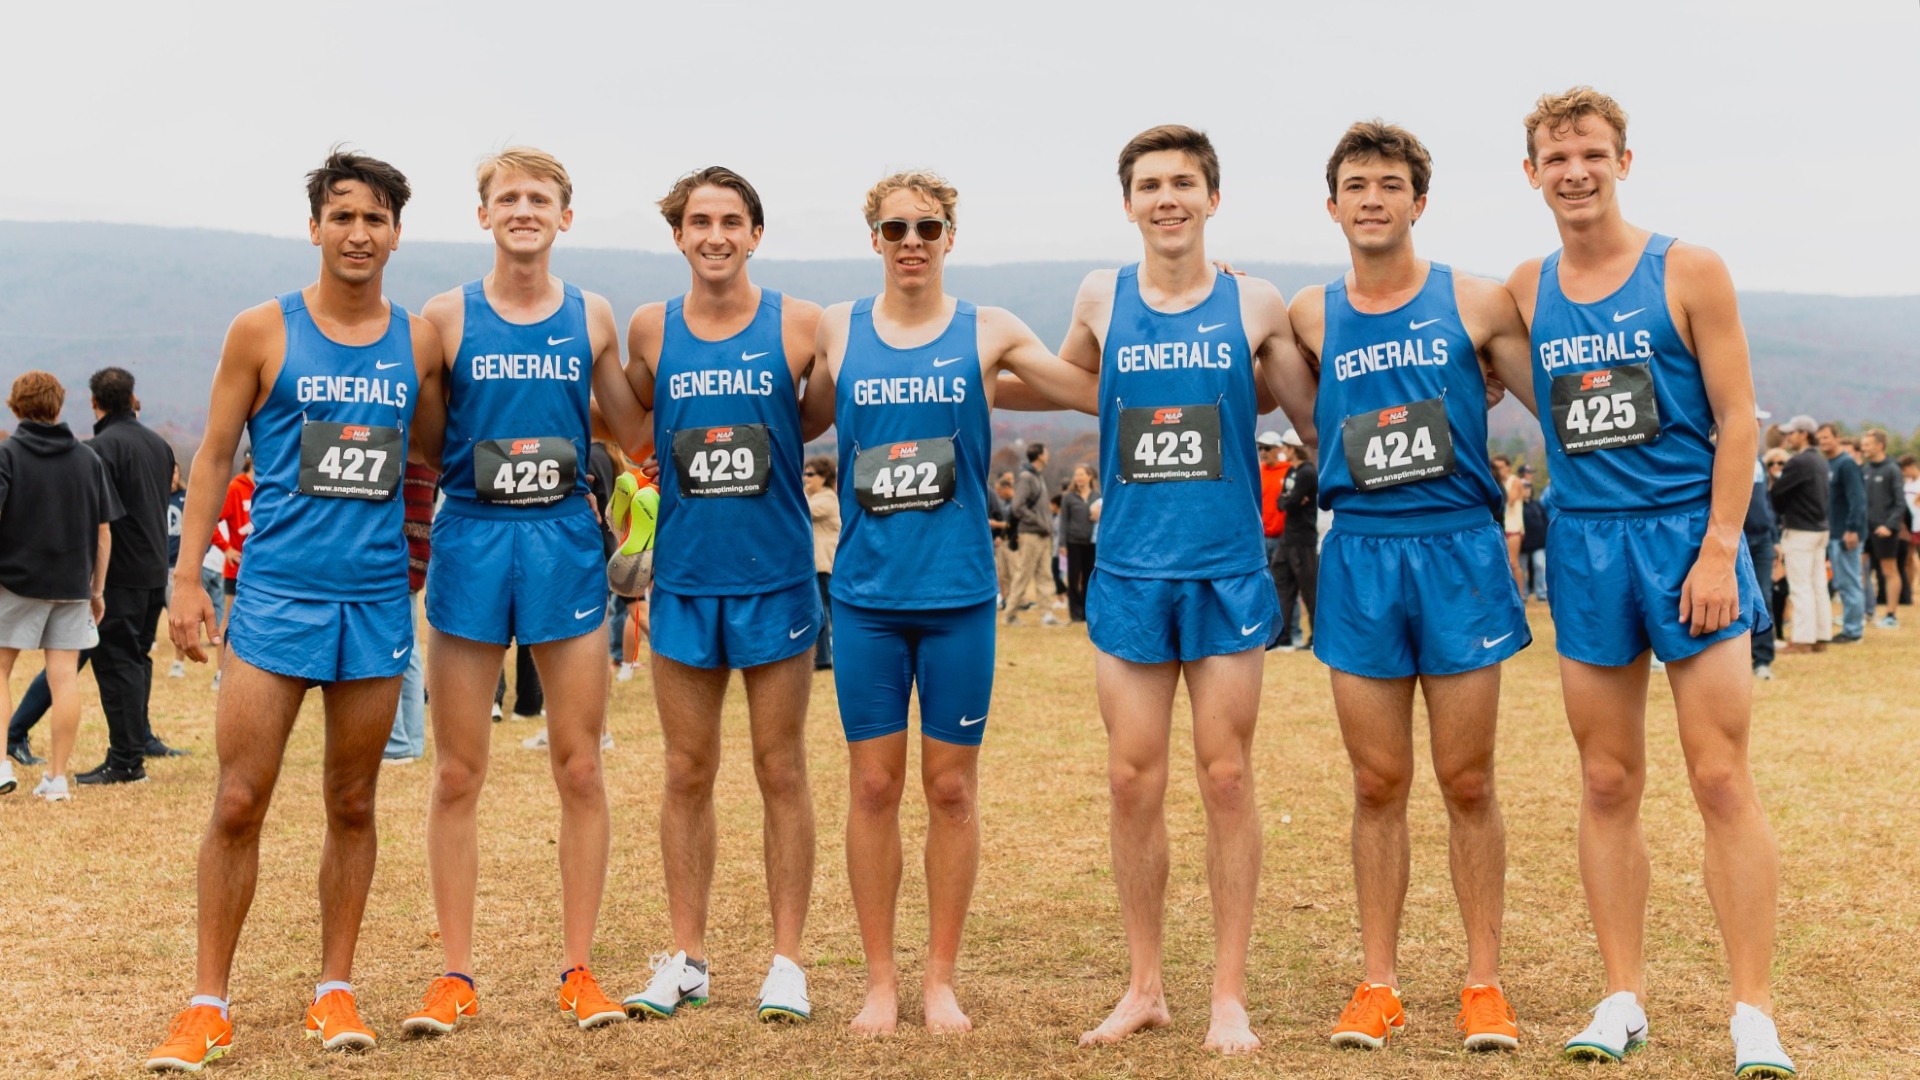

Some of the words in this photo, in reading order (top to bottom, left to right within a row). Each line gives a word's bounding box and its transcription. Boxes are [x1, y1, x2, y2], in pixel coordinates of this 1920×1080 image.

[1117, 342, 1231, 373] GENERALS
[1335, 338, 1448, 381] GENERALS
[1540, 330, 1650, 371] GENERALS
[472, 354, 580, 381] GENERALS
[1580, 369, 1612, 391] SNAP
[297, 376, 407, 408] GENERALS
[669, 369, 773, 399] GENERALS
[854, 376, 966, 405] GENERALS
[1151, 408, 1183, 424] SNAP
[1377, 406, 1408, 427] SNAP
[1566, 391, 1637, 434] 425
[340, 425, 371, 440] SNAP
[704, 427, 734, 444] SNAP
[1566, 432, 1645, 450] www.snaptiming.com
[509, 439, 540, 455] SNAP
[888, 442, 918, 460] SNAP
[1134, 430, 1202, 466] 423
[1364, 426, 1436, 470] 424
[318, 446, 387, 482] 427
[493, 459, 560, 494] 426
[688, 447, 754, 482] 429
[1132, 470, 1207, 479] www.snaptiming.com
[1364, 465, 1444, 486] www.snaptiming.com
[313, 485, 389, 496] www.snaptiming.com
[872, 462, 940, 499] 422
[872, 498, 944, 512] www.snaptiming.com
